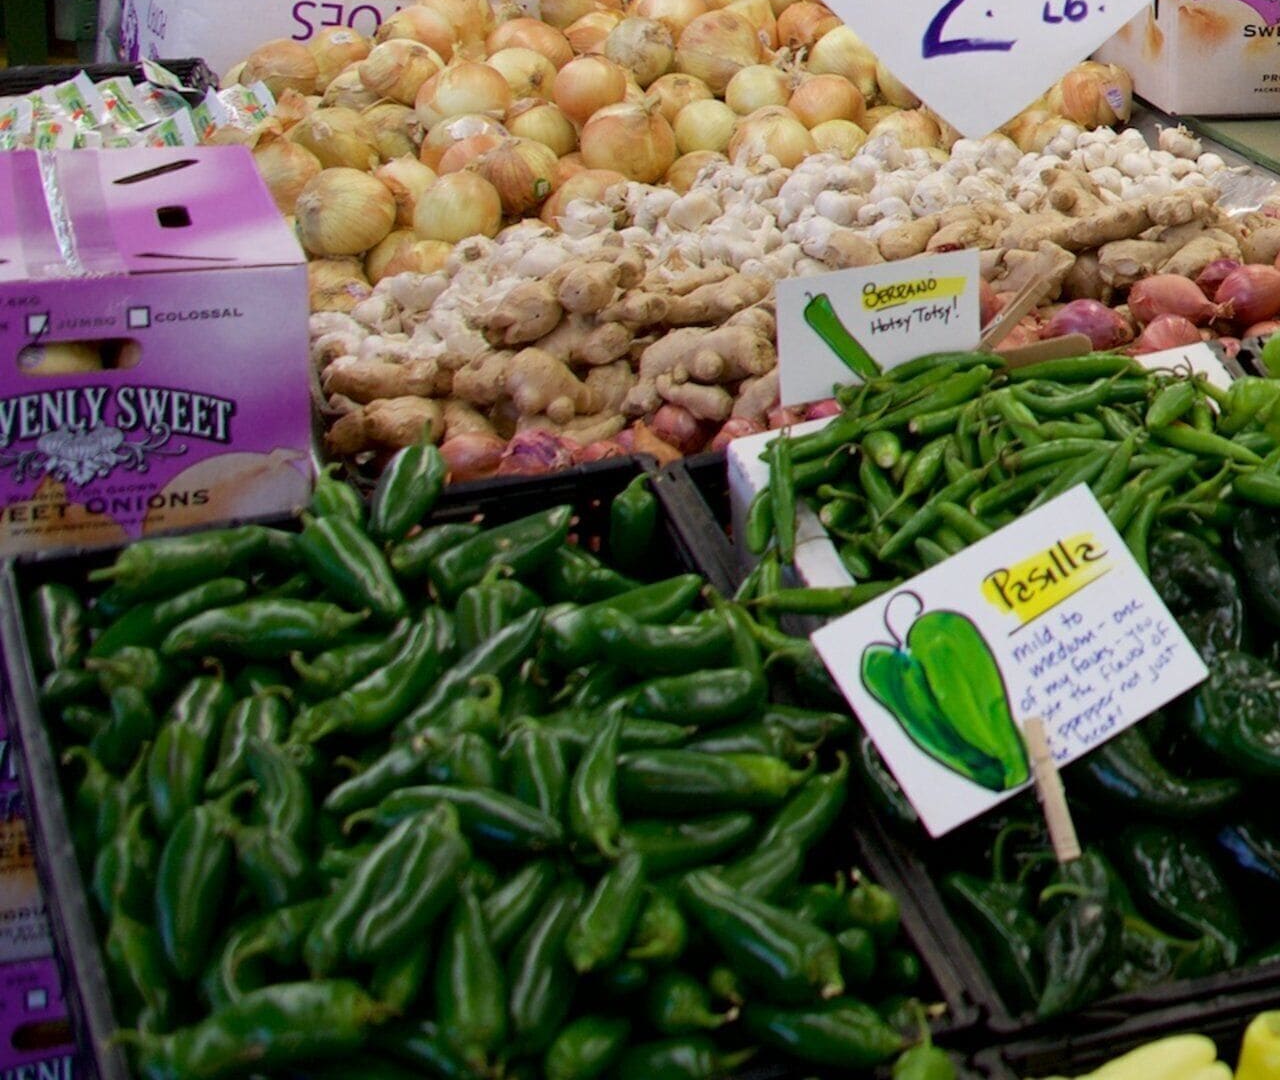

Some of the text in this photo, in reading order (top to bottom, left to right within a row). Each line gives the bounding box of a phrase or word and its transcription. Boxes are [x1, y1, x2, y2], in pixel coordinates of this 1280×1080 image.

[862, 278, 937, 309] SERRANO
[154, 307, 244, 323] COLOSSAL
[116, 385, 237, 444] SWEET
[84, 489, 210, 514] ONIONS
[983, 539, 1109, 610] Pasilla
[1011, 610, 1083, 663] mild to
